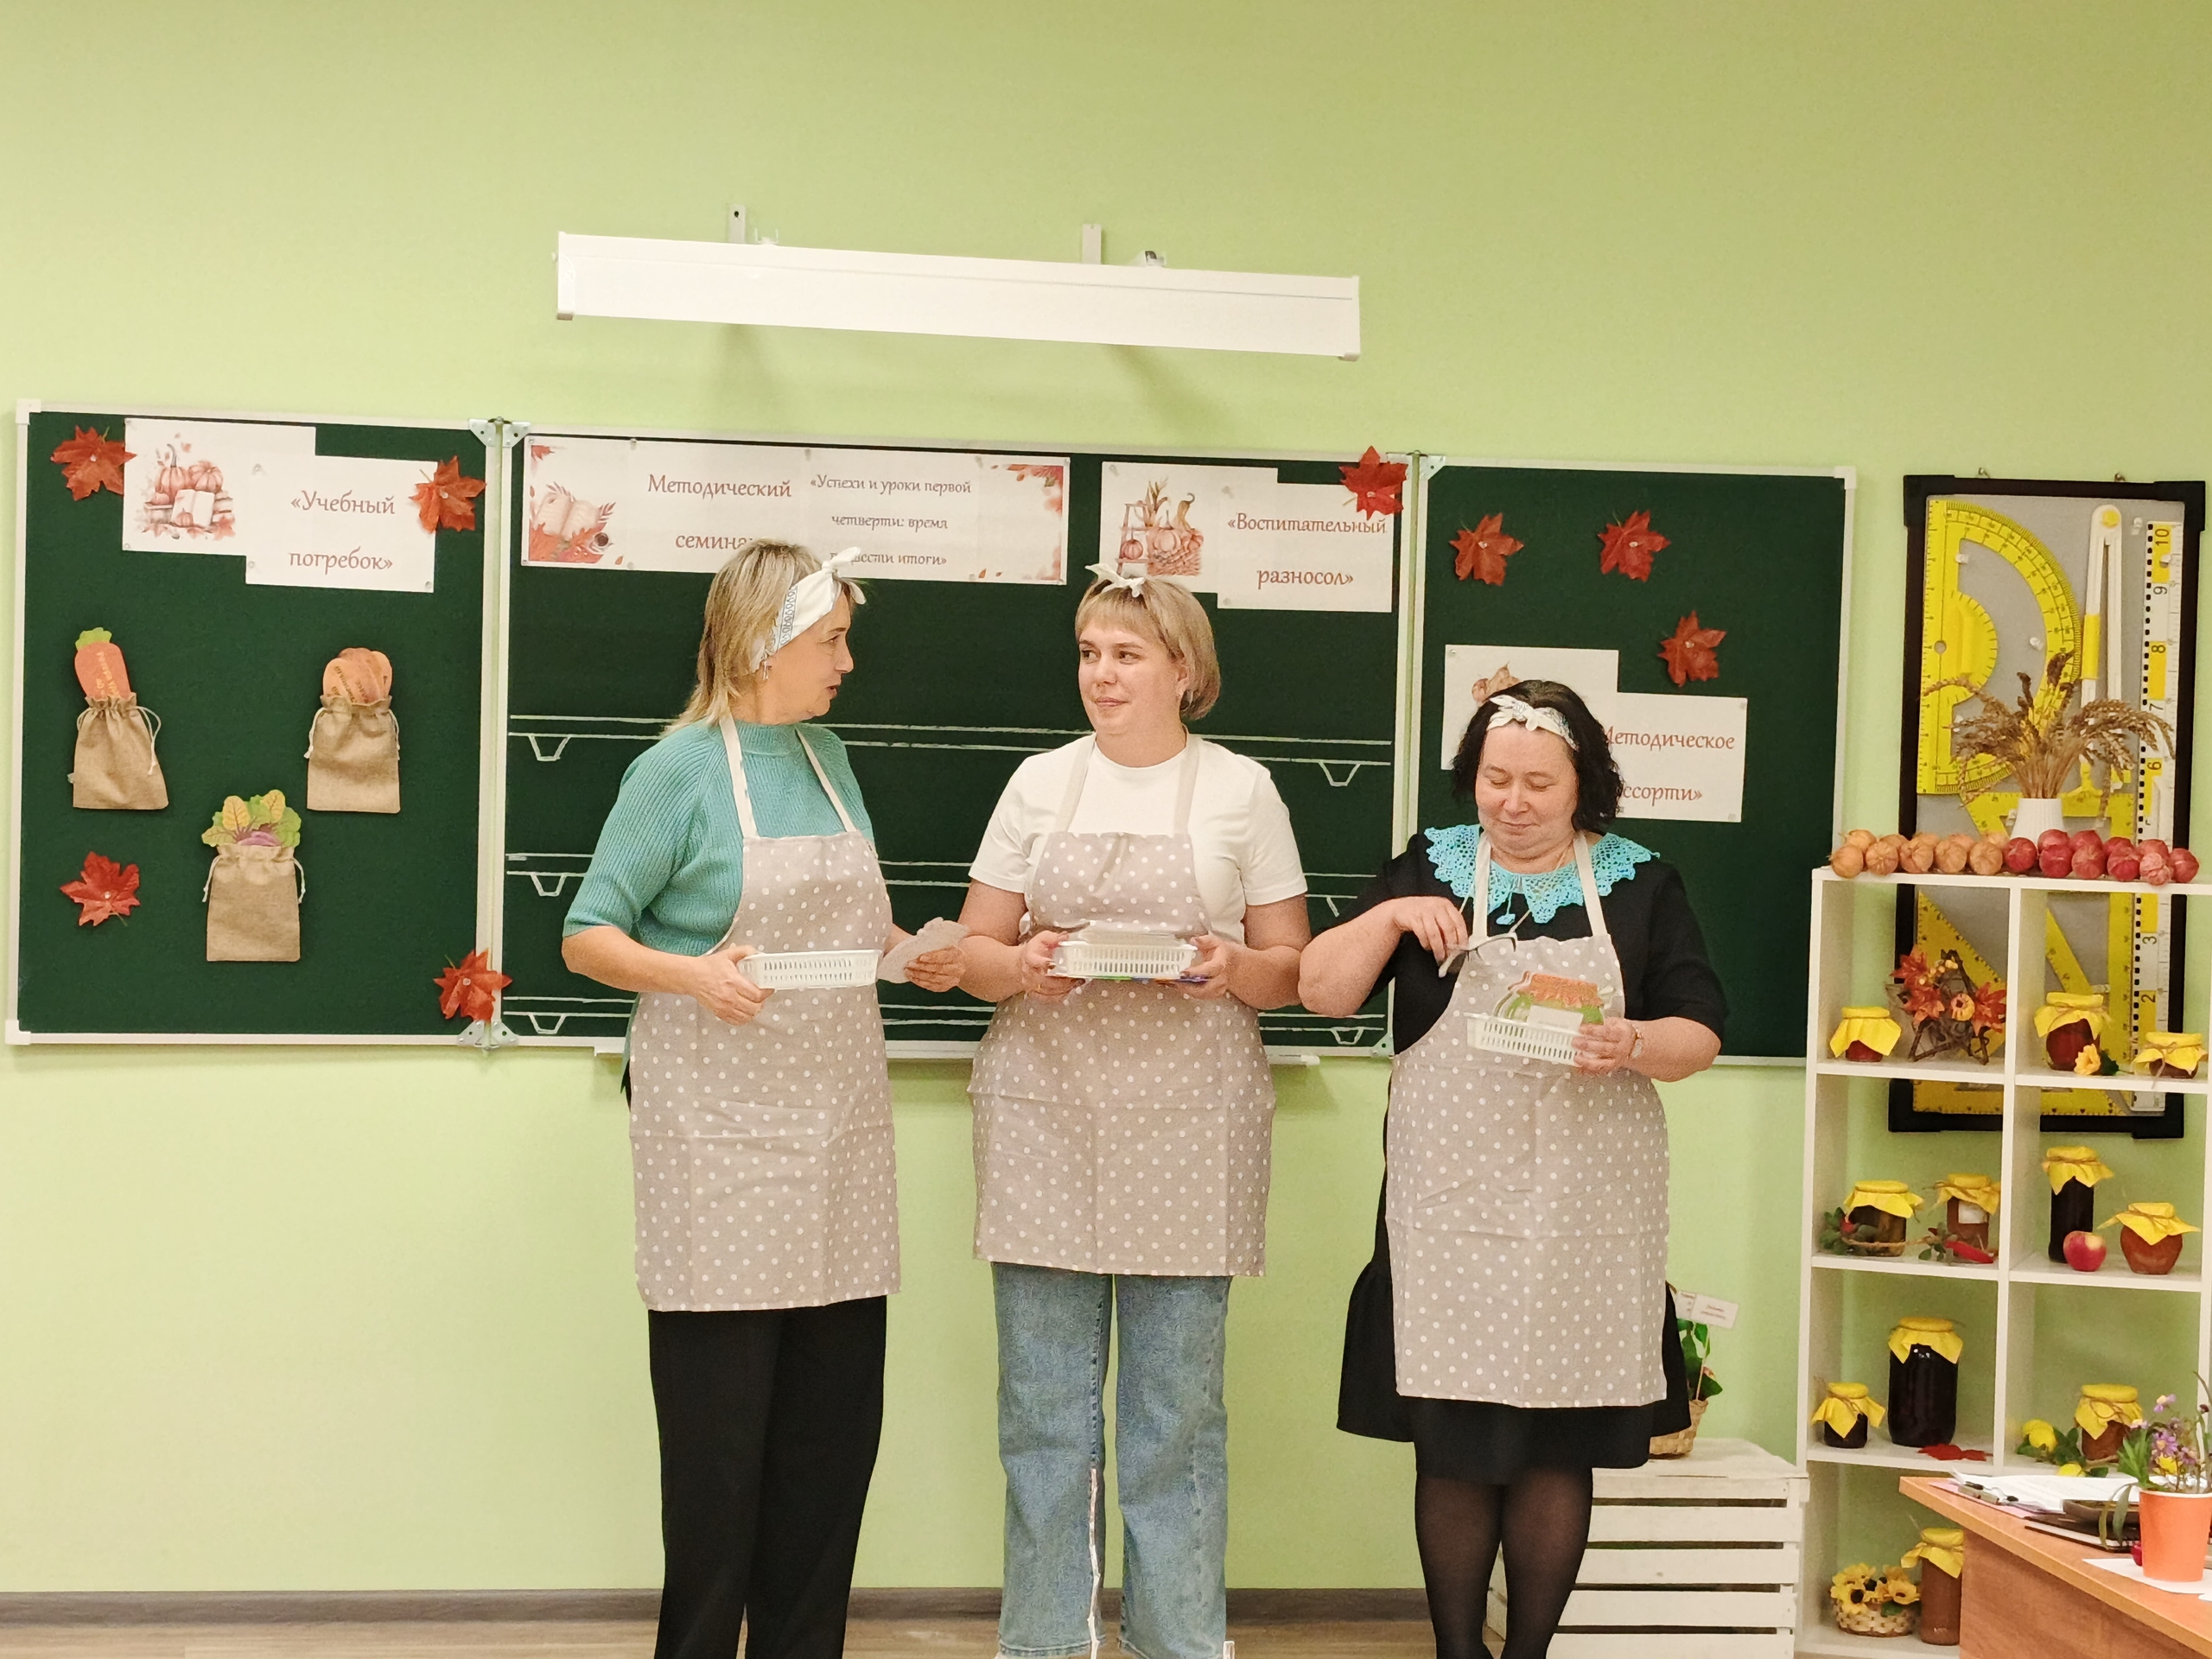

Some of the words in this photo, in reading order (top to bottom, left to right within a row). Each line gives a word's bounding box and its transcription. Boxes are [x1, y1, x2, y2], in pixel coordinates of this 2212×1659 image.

[647, 474, 792, 499] Методический
[810, 474, 865, 489] «Успехи
[869, 480, 878, 490] и
[880, 480, 921, 495] уроки
[925, 480, 971, 497] первой
[290, 489, 396, 514] «Учебный
[831, 516, 905, 531] четверти:
[908, 518, 948, 532] время
[1227, 512, 1387, 534] «Воспитательный
[675, 534, 753, 550] семина
[2155, 528, 2170, 546] 10
[289, 546, 393, 575] погребок»
[898, 554, 947, 565] итоги»
[1257, 569, 1354, 589] разносол»
[2151, 645, 2166, 653] 8
[2142, 936, 2158, 945] 3
[2140, 994, 2156, 1003] 2
